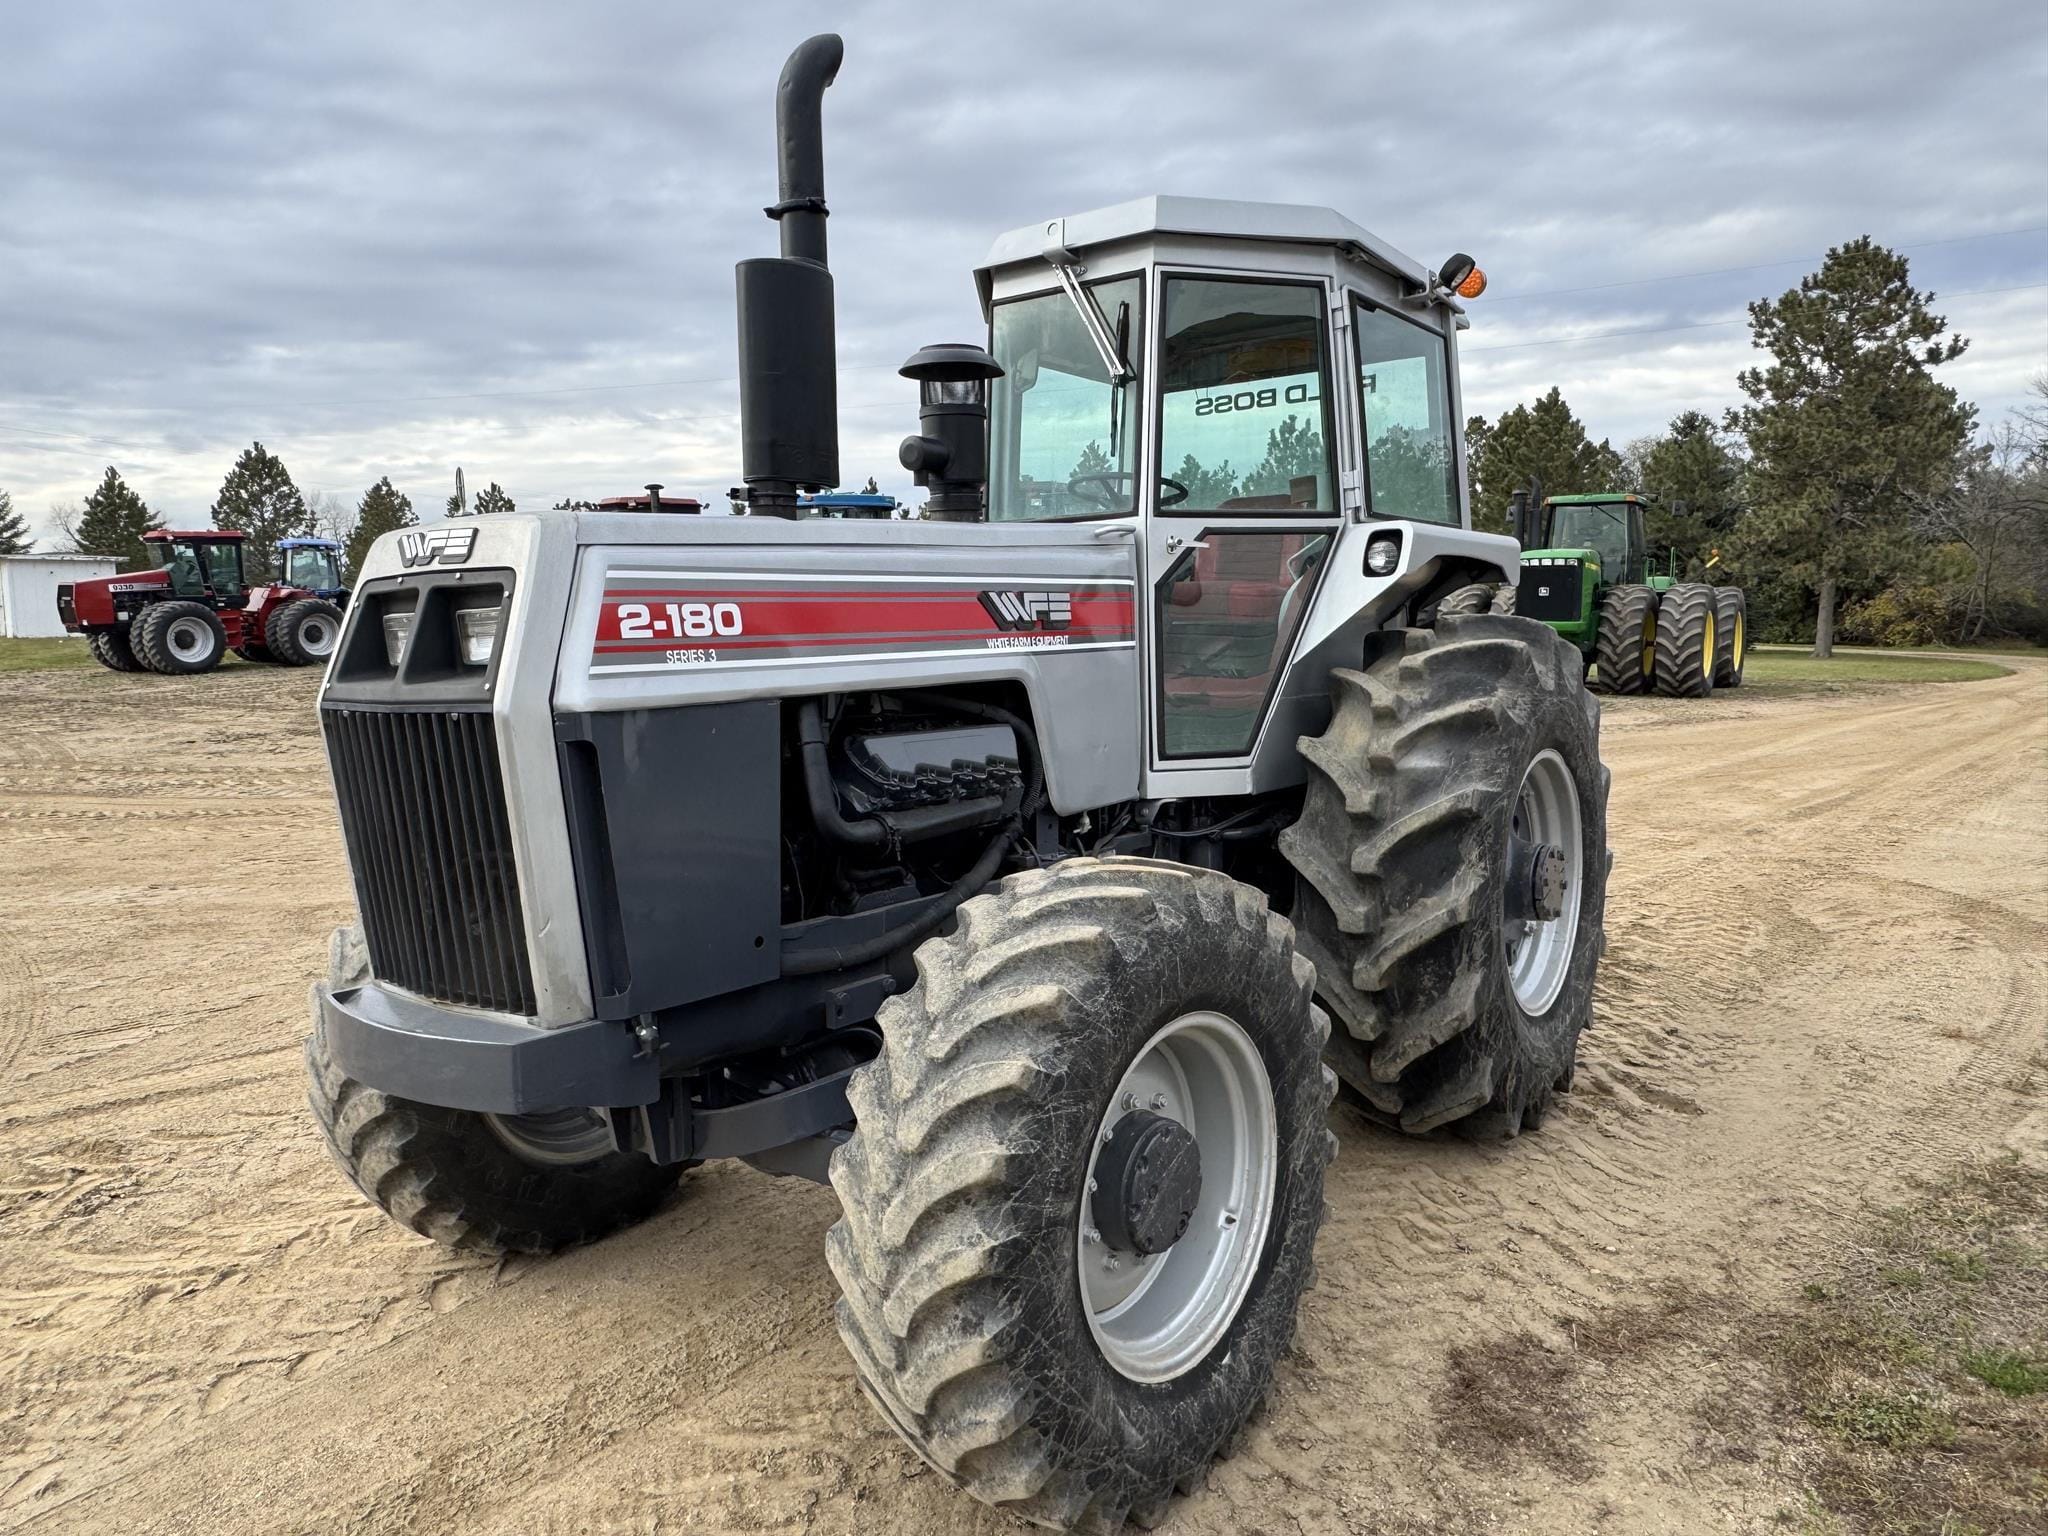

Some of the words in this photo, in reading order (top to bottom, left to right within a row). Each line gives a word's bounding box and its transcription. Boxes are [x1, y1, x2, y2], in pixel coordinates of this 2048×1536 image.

[617, 602, 743, 639] 2-180
[986, 637, 1010, 649] WHITE
[665, 648, 706, 664] SERIES
[708, 648, 717, 663] 3
